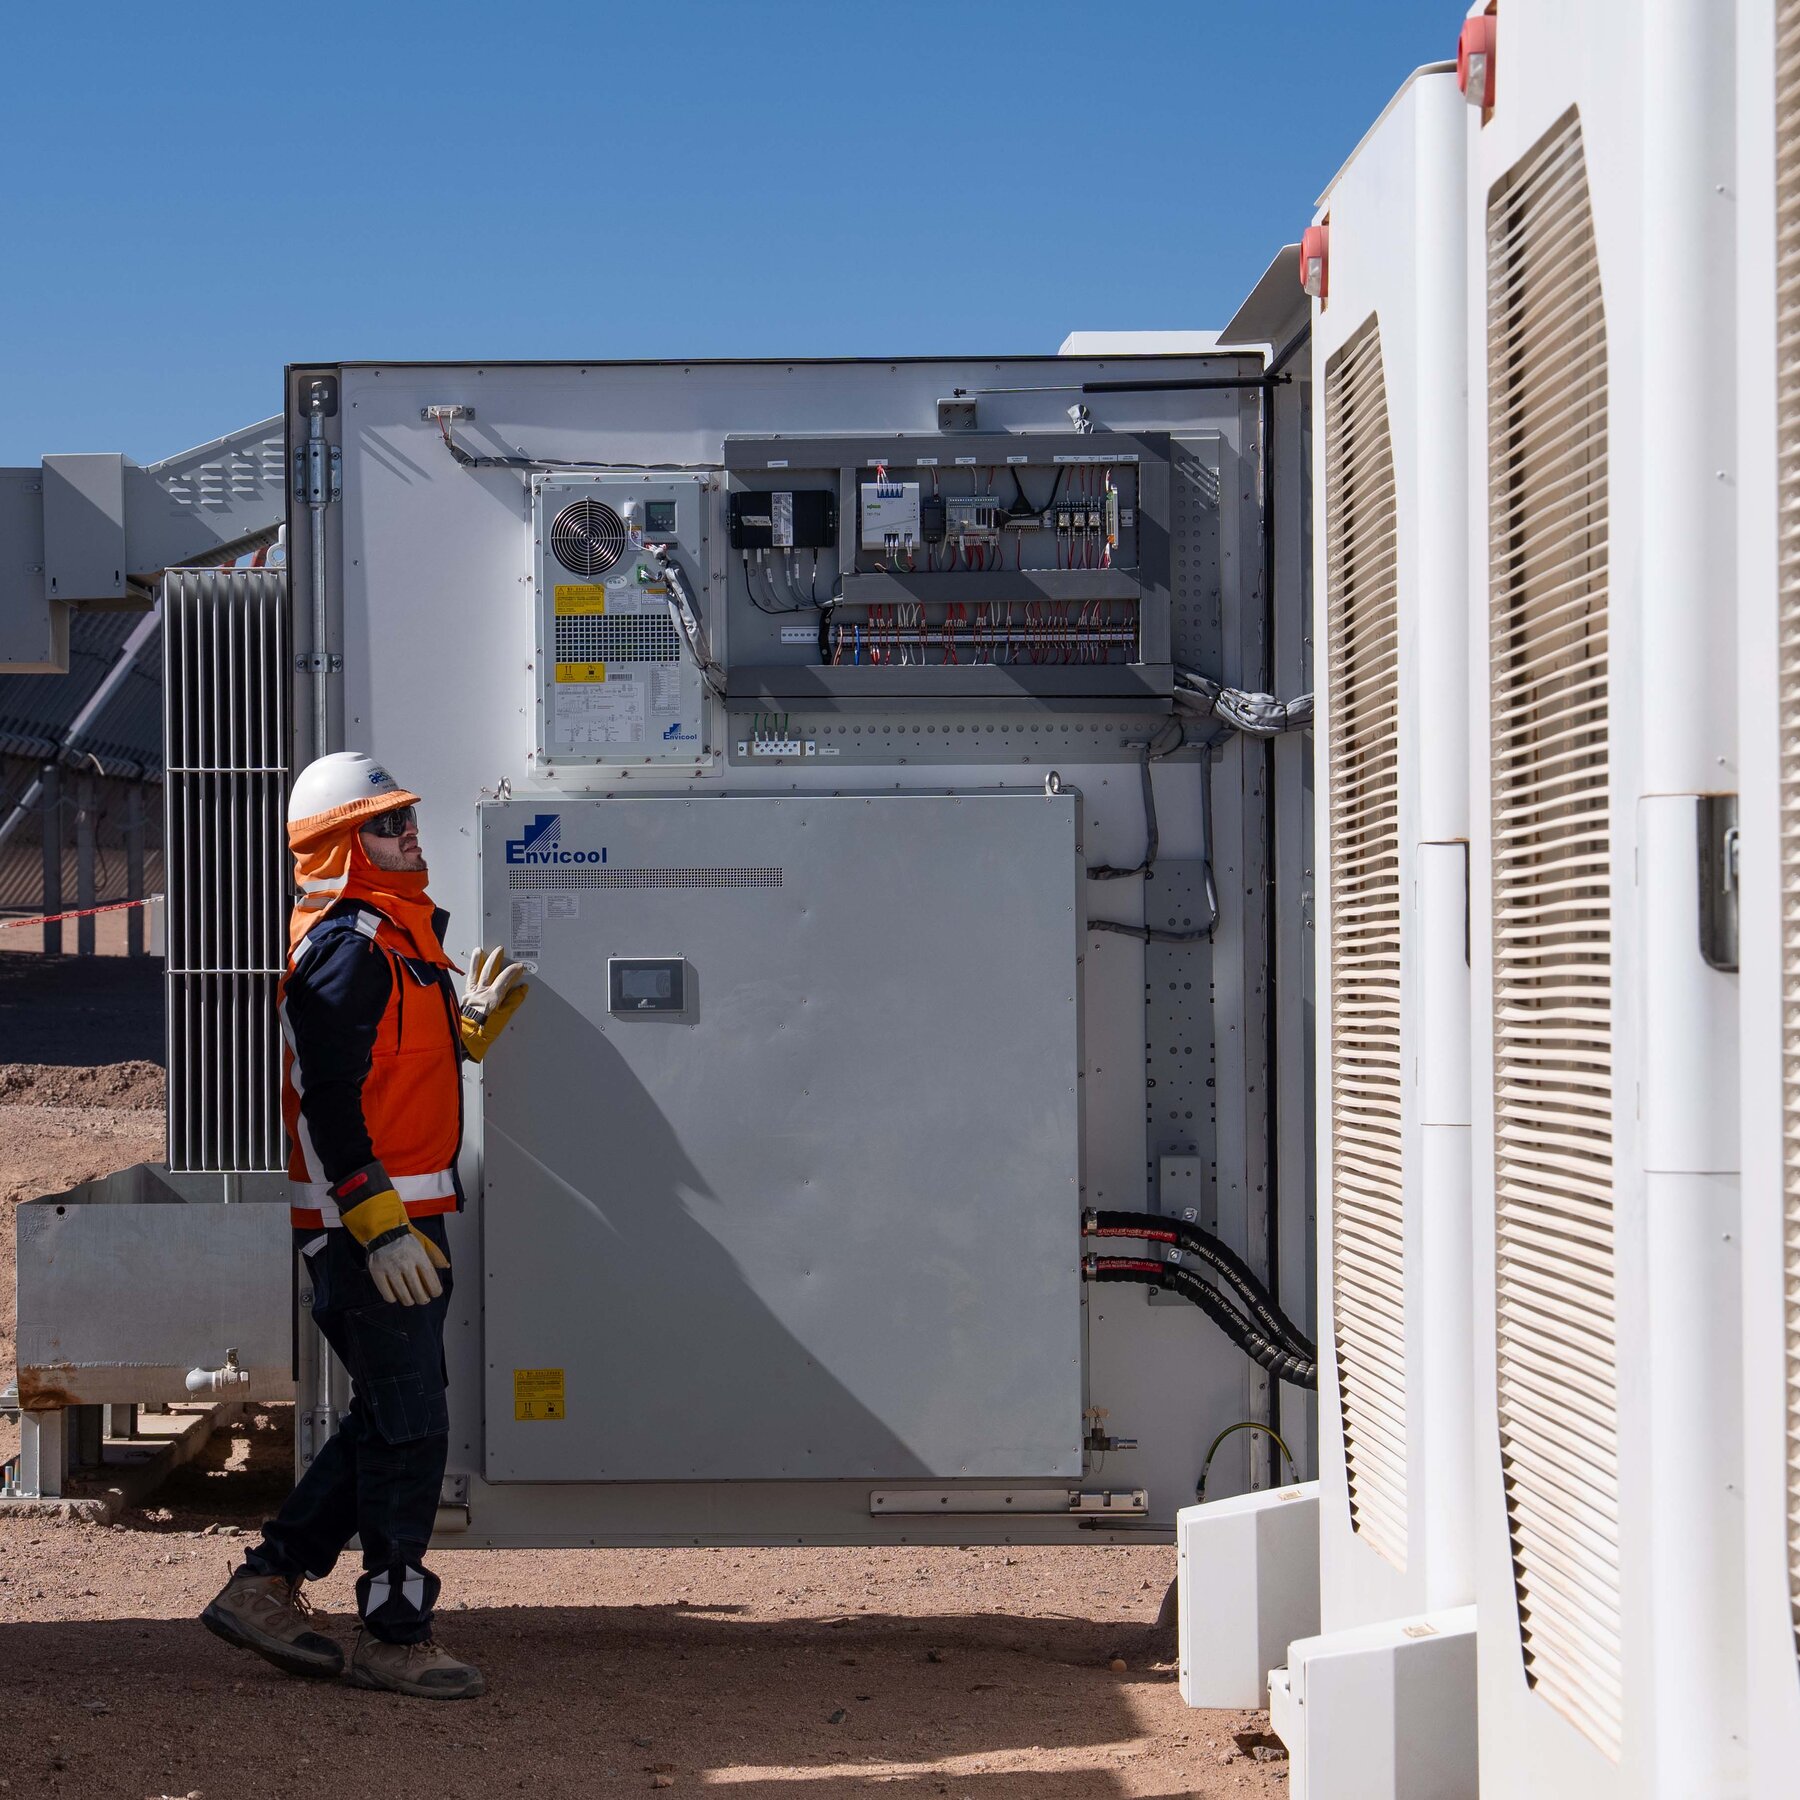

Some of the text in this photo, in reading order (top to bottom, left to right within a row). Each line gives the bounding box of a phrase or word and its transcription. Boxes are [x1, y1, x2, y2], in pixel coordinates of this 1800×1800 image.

[663, 731, 698, 740] Envicool
[506, 840, 607, 864] Envicool
[1200, 1246, 1214, 1260] WALL
[1188, 1276, 1204, 1290] WALL
